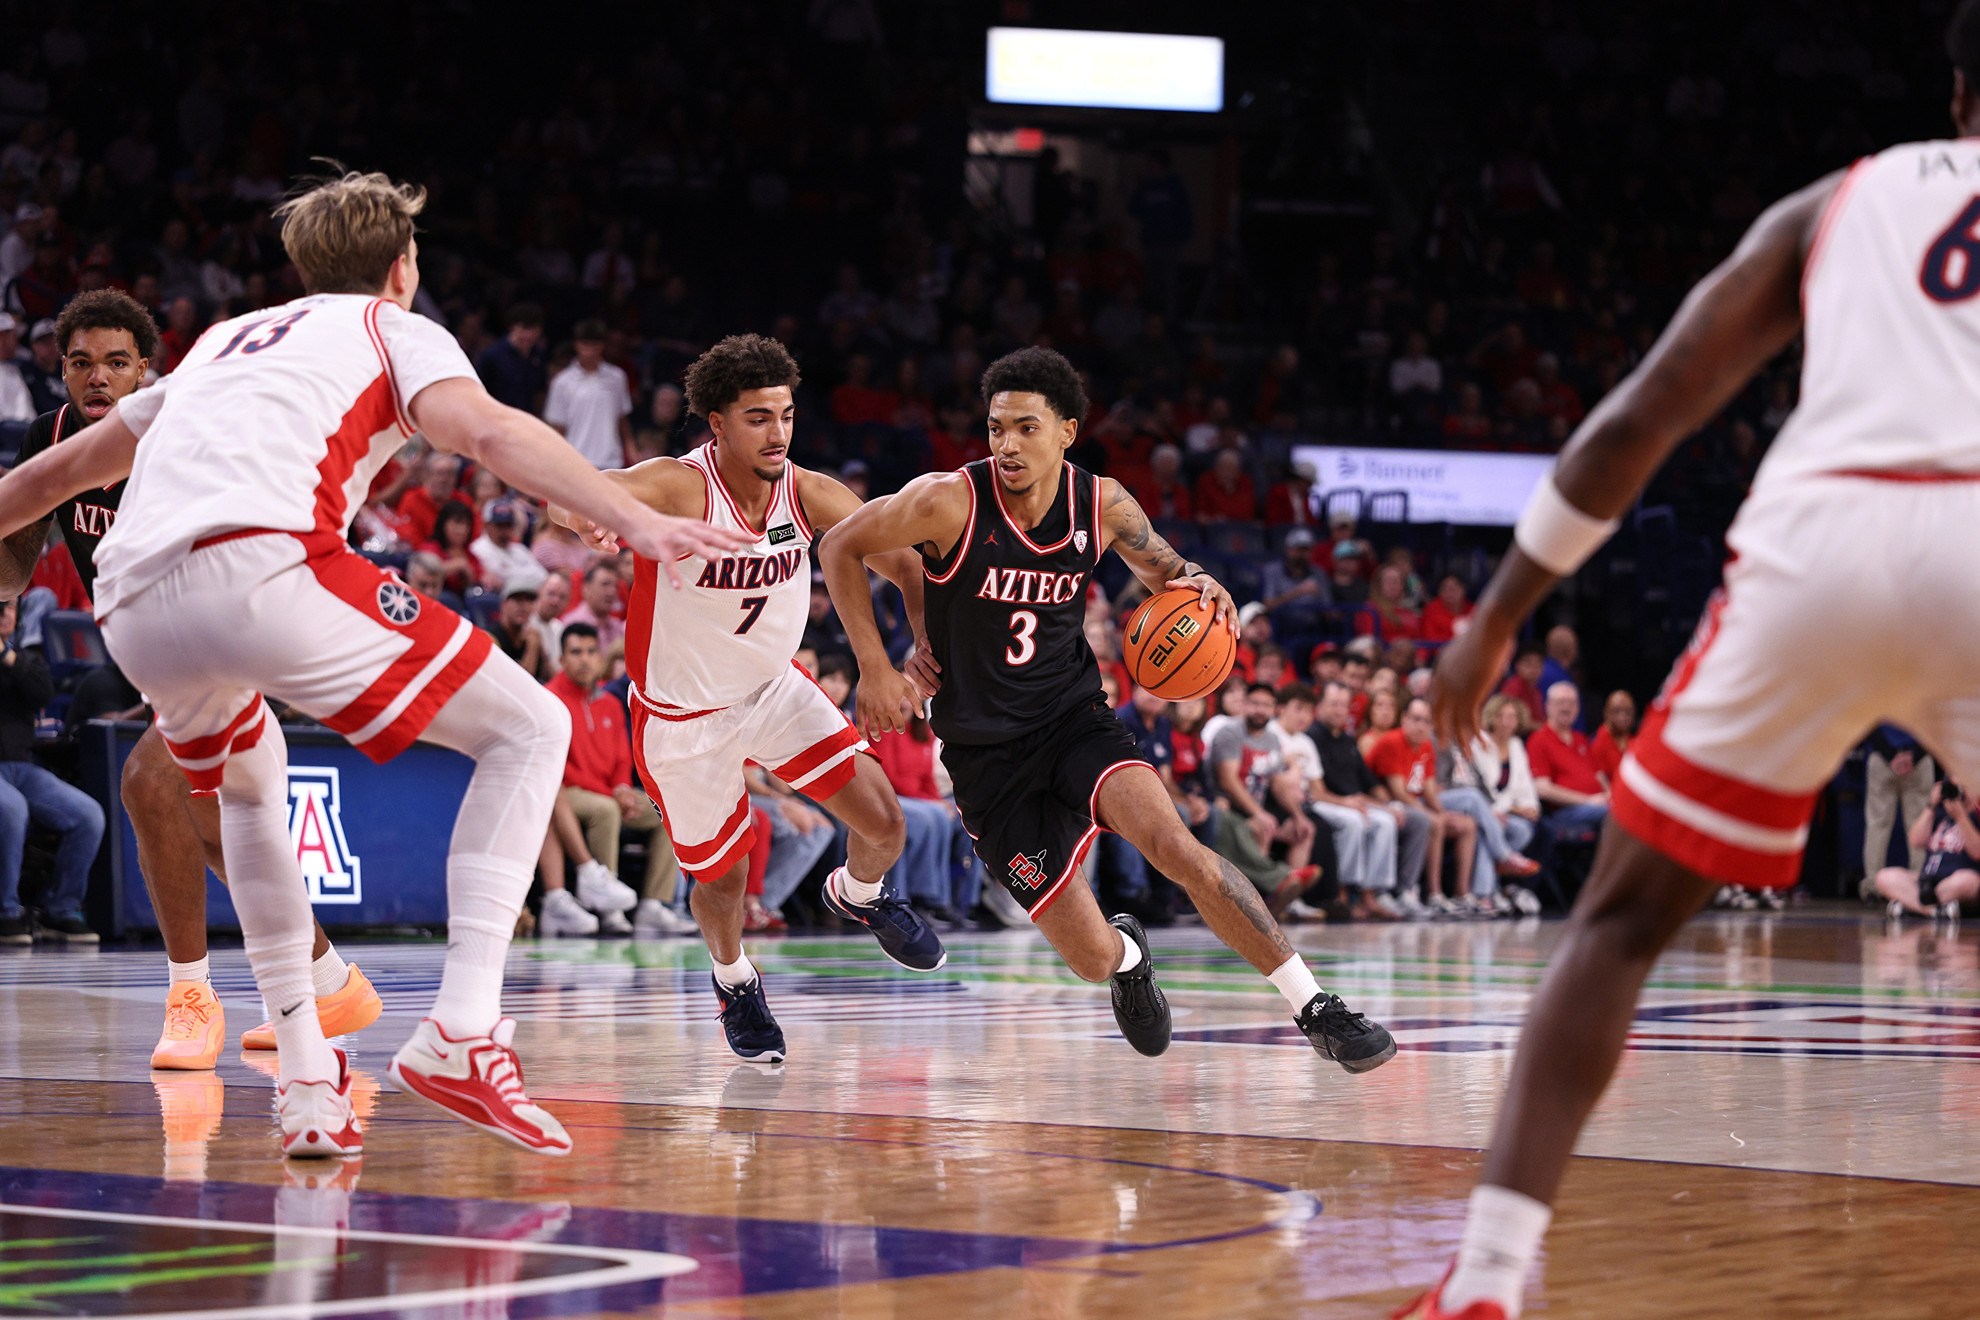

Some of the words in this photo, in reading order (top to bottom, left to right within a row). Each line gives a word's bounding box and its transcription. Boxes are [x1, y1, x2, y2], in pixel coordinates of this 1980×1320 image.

[1919, 193, 1980, 304] 6
[212, 308, 312, 361] 13
[73, 500, 118, 538] AZT
[695, 548, 802, 590] ARIZONA
[974, 566, 1086, 605] AZTECS
[733, 596, 769, 635] 7
[1005, 609, 1039, 667] 3
[1148, 614, 1196, 668] ELITE
